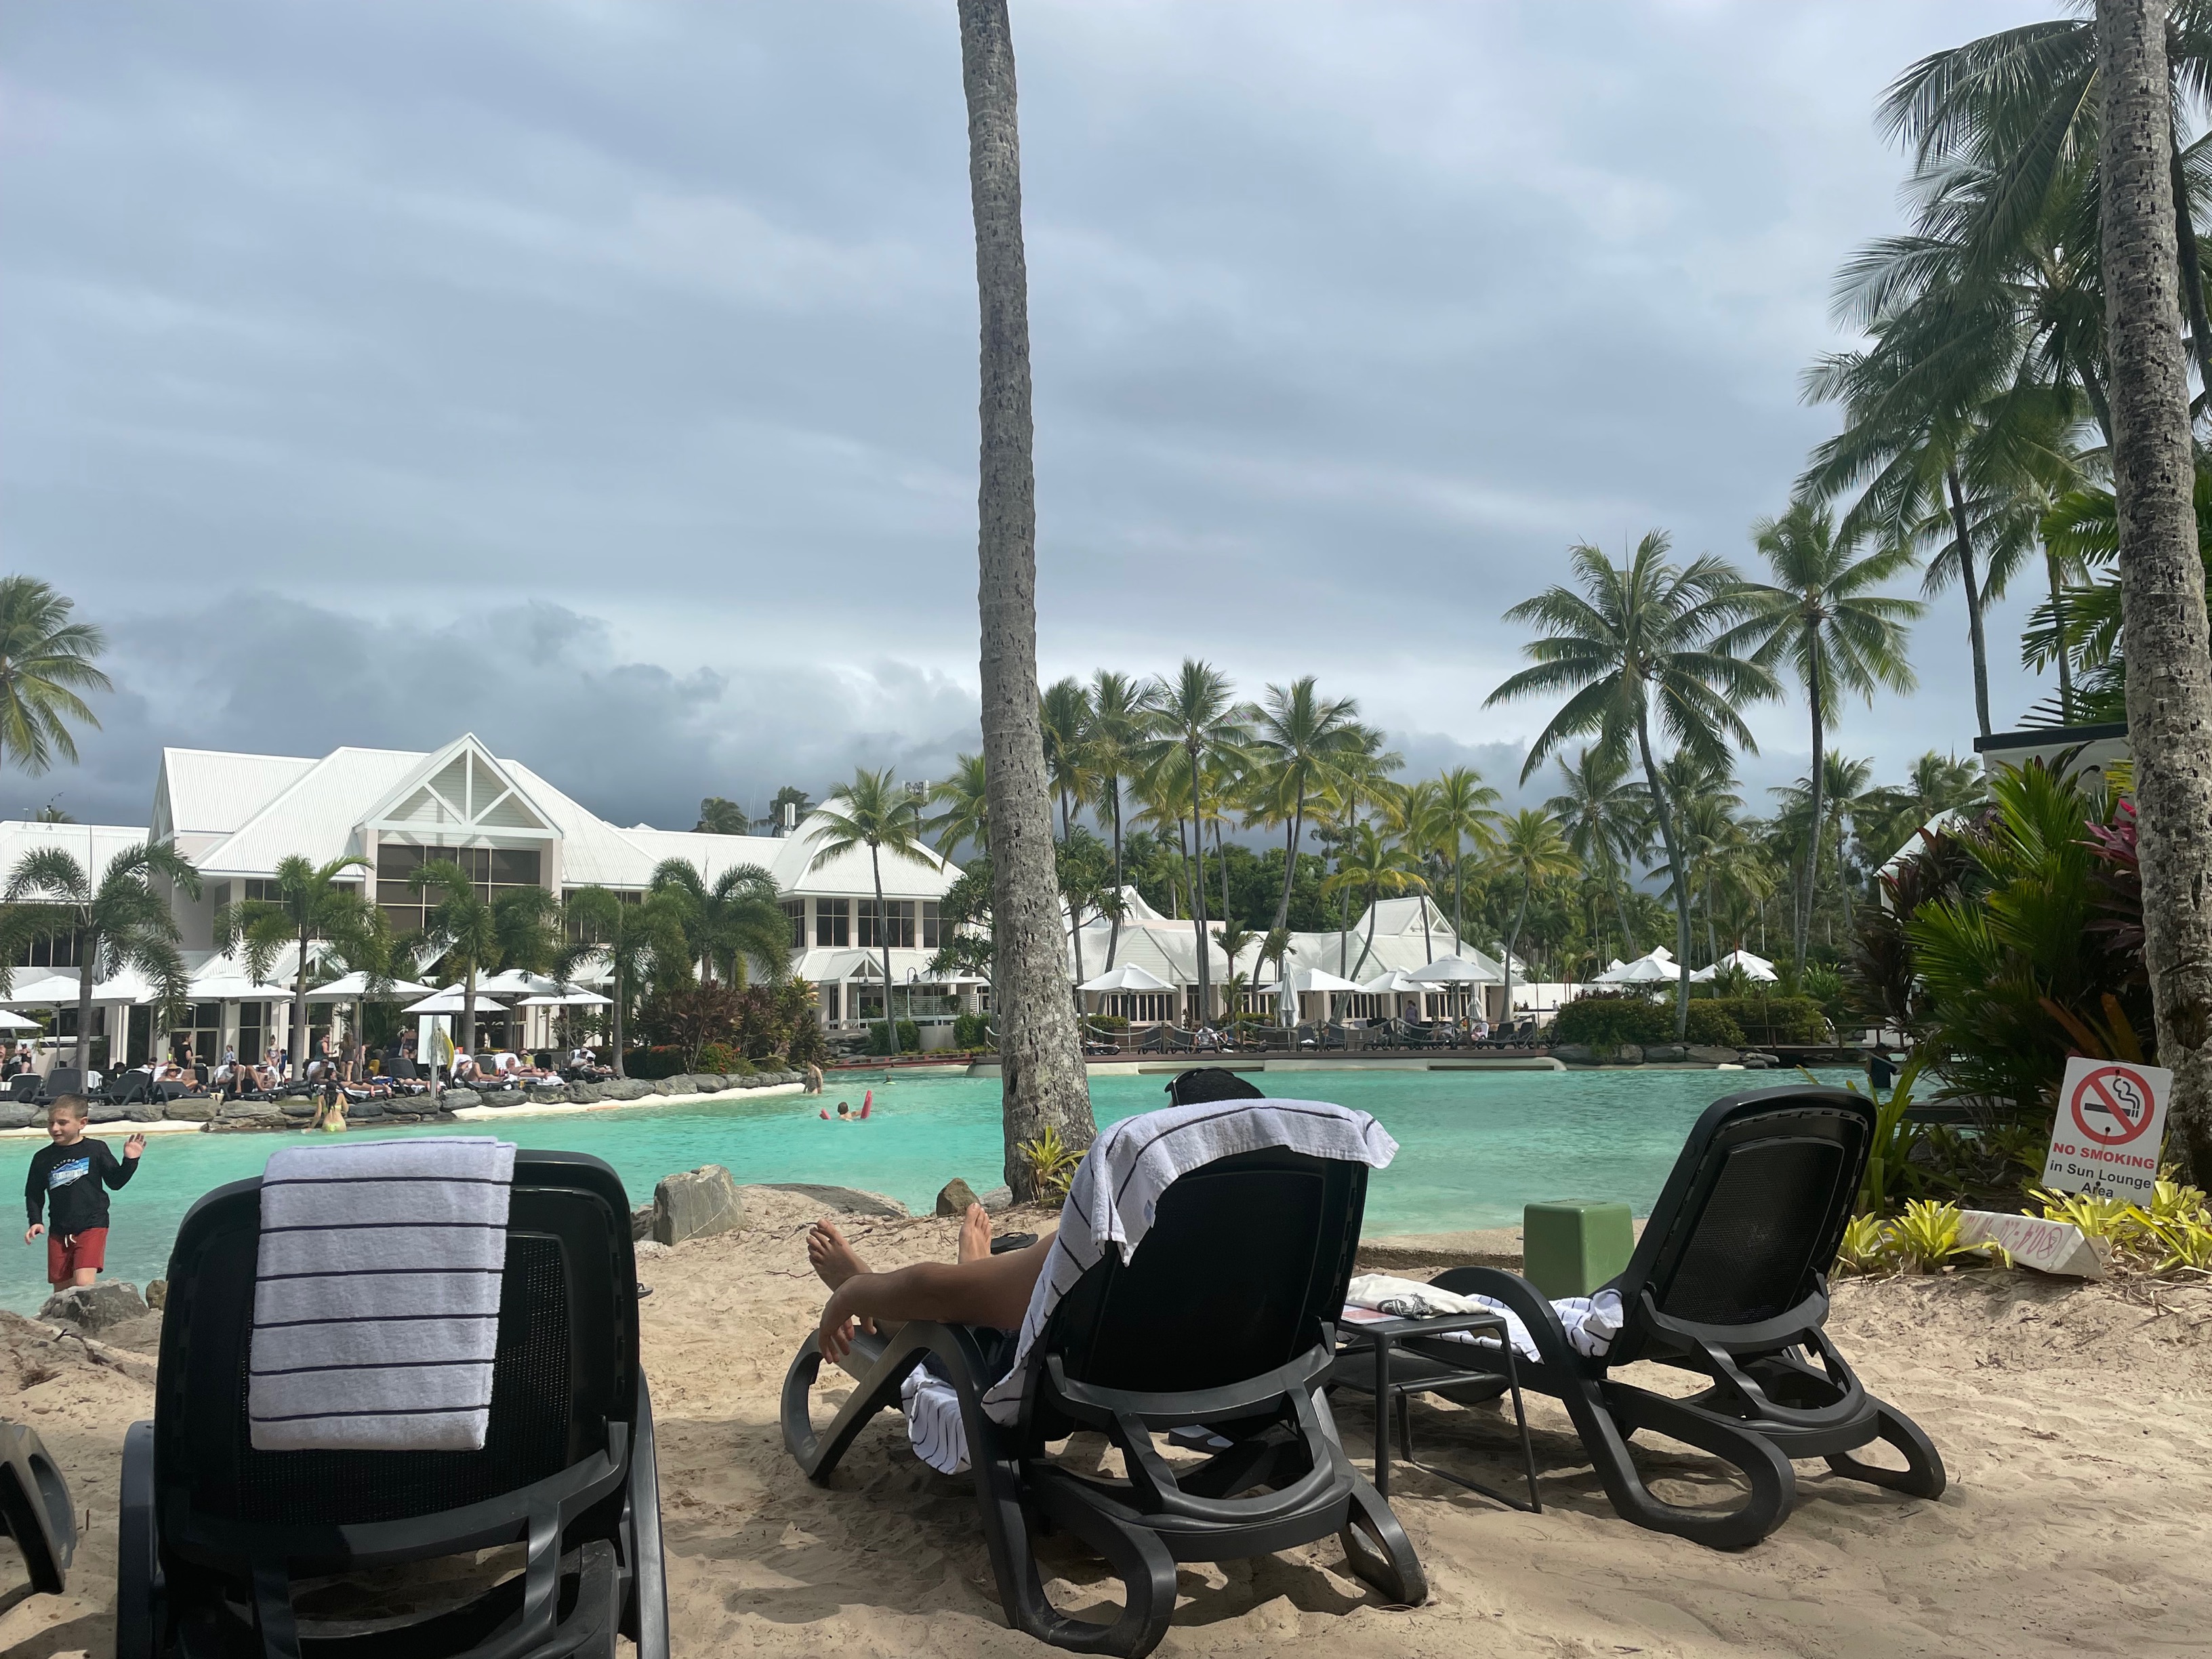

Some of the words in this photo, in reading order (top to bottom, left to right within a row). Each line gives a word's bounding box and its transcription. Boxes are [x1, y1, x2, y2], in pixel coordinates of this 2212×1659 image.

[2053, 1143, 2076, 1155] NO
[2080, 1147, 2154, 1169] SMOKING
[2050, 1160, 2062, 1172] in
[2067, 1164, 2094, 1179] Sun
[2099, 1169, 2152, 1190] Lounge
[2081, 1183, 2114, 1197] Area
